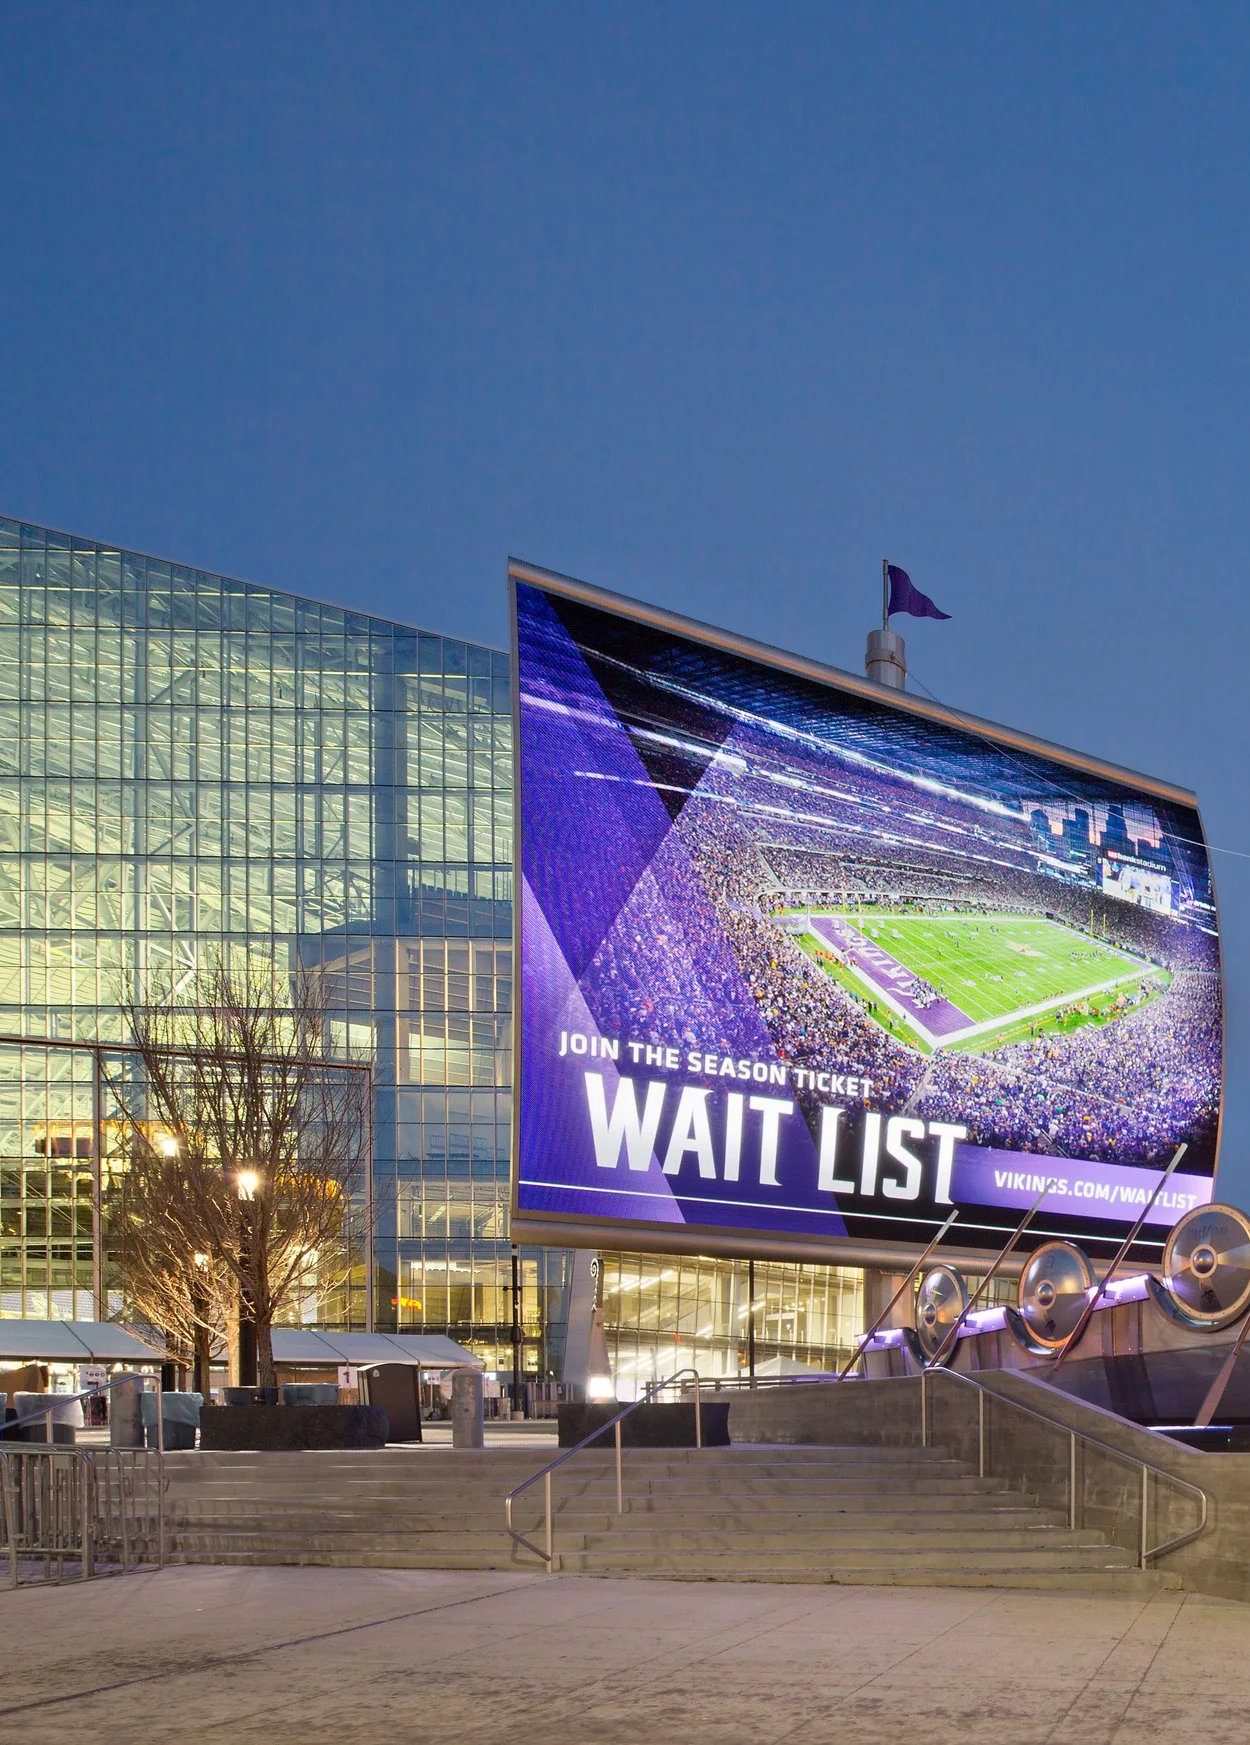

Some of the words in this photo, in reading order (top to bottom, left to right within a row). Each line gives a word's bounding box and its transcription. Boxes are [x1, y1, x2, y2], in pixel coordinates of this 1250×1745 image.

[558, 1031, 619, 1061] JOIN
[627, 1041, 680, 1070] THE
[686, 1051, 787, 1086] SEASON
[794, 1068, 875, 1098] TICKET
[584, 1071, 794, 1187] WAIT
[817, 1105, 968, 1206] LIST
